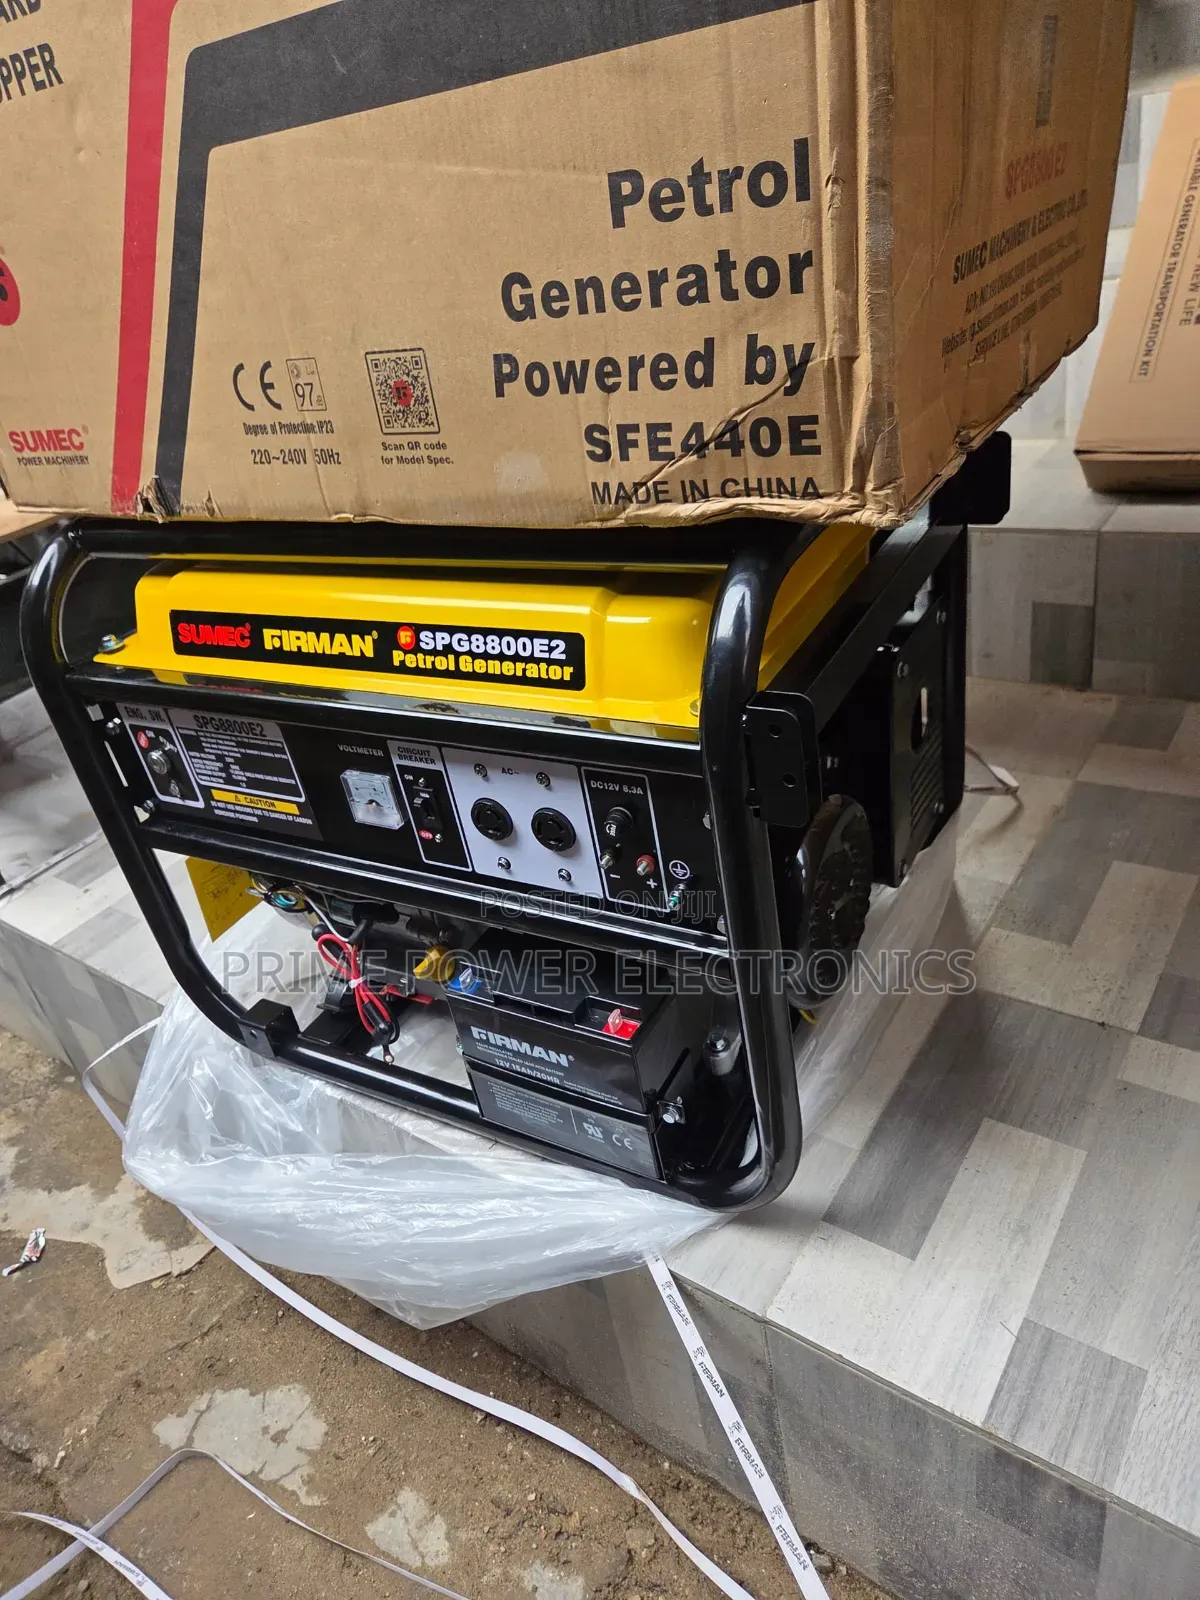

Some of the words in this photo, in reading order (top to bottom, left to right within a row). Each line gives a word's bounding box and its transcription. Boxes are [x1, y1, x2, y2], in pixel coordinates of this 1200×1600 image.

[0, 42, 64, 104] PPER
[606, 137, 812, 229] Petrol
[1169, 194, 1195, 258] GENERATOR
[953, 241, 987, 285] SUMEC
[501, 248, 814, 322] Generator
[1143, 262, 1177, 357] TRANSPORTATION
[1179, 298, 1196, 326] LIFE
[492, 336, 715, 398] Powered
[744, 333, 815, 397] by
[1138, 360, 1151, 376] KIT
[232, 361, 282, 411] CE
[294, 382, 314, 407] 97
[8, 428, 84, 453] SUMEC
[243, 423, 268, 437] Degree
[270, 422, 278, 434] of
[317, 420, 334, 434] IP23
[584, 415, 822, 463] SFE440E
[251, 449, 308, 465] 220~240V
[314, 449, 342, 465] 50Hz
[381, 441, 405, 451] Scan
[407, 441, 420, 451] QR
[424, 441, 447, 451] code
[17, 456, 43, 466] POWER
[44, 455, 89, 465] MACHINERY
[381, 456, 391, 465] for
[396, 455, 424, 465] Model
[428, 455, 454, 466] Spec.
[591, 480, 669, 506] MADE
[681, 478, 710, 504] IN
[720, 476, 823, 501] CHINA
[177, 622, 250, 649] SUMEC
[263, 628, 375, 657] FIRMAN
[420, 630, 567, 660] SPG8800E2
[393, 650, 456, 672] Petrol
[459, 654, 574, 681] Generator
[124, 706, 147, 720] ENG.
[150, 710, 165, 722] SW.
[193, 715, 267, 738] SPG8800E2
[337, 744, 384, 757] VOLTMETER
[397, 746, 431, 757] CIRCUIT
[397, 754, 436, 765] BREAKER
[590, 780, 620, 792] DC12V
[623, 785, 643, 795] 8.3A
[244, 796, 276, 809] CAUTION
[471, 1026, 569, 1067] FIRMAN
[495, 1058, 510, 1070] 12V
[511, 1062, 560, 1084] 15Ah/20HR
[698, 1361, 725, 1398] FIRMAN
[735, 1437, 764, 1479] FIRMAN
[775, 1524, 809, 1571] FIRMAN
